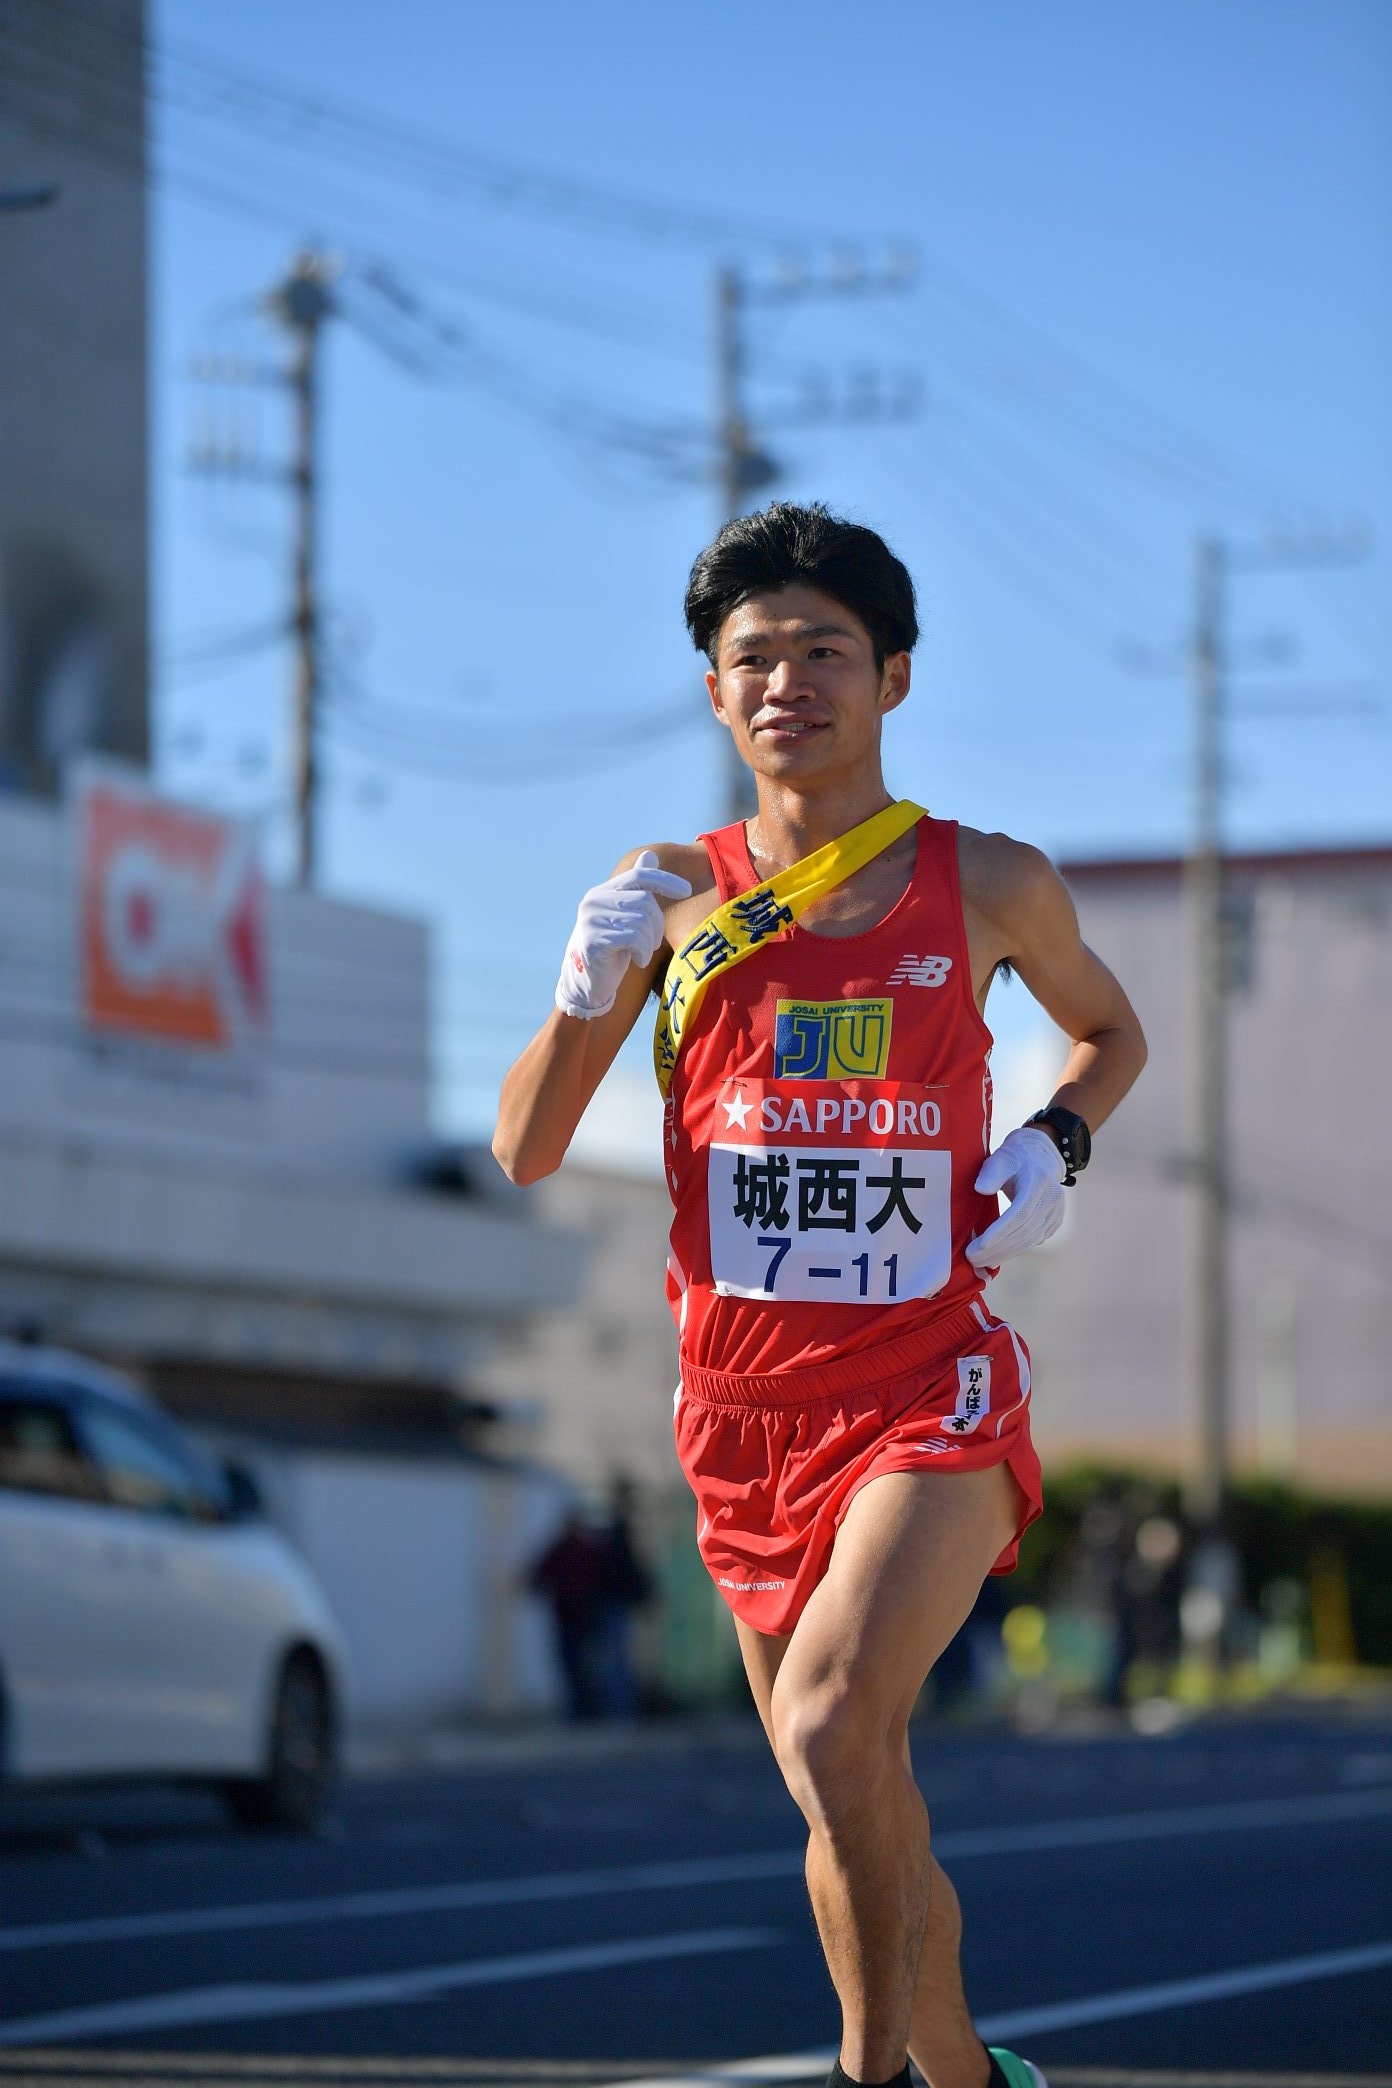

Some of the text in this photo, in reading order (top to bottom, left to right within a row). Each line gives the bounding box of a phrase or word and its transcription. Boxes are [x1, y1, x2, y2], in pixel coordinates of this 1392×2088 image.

[788, 1003, 885, 1016] JOSAI UNIVERSITY
[782, 1014, 885, 1078] JU
[759, 1096, 942, 1137] SAPPORO
[732, 1153, 927, 1235] 城西大
[735, 1580, 786, 1593] UNIVERSITY
